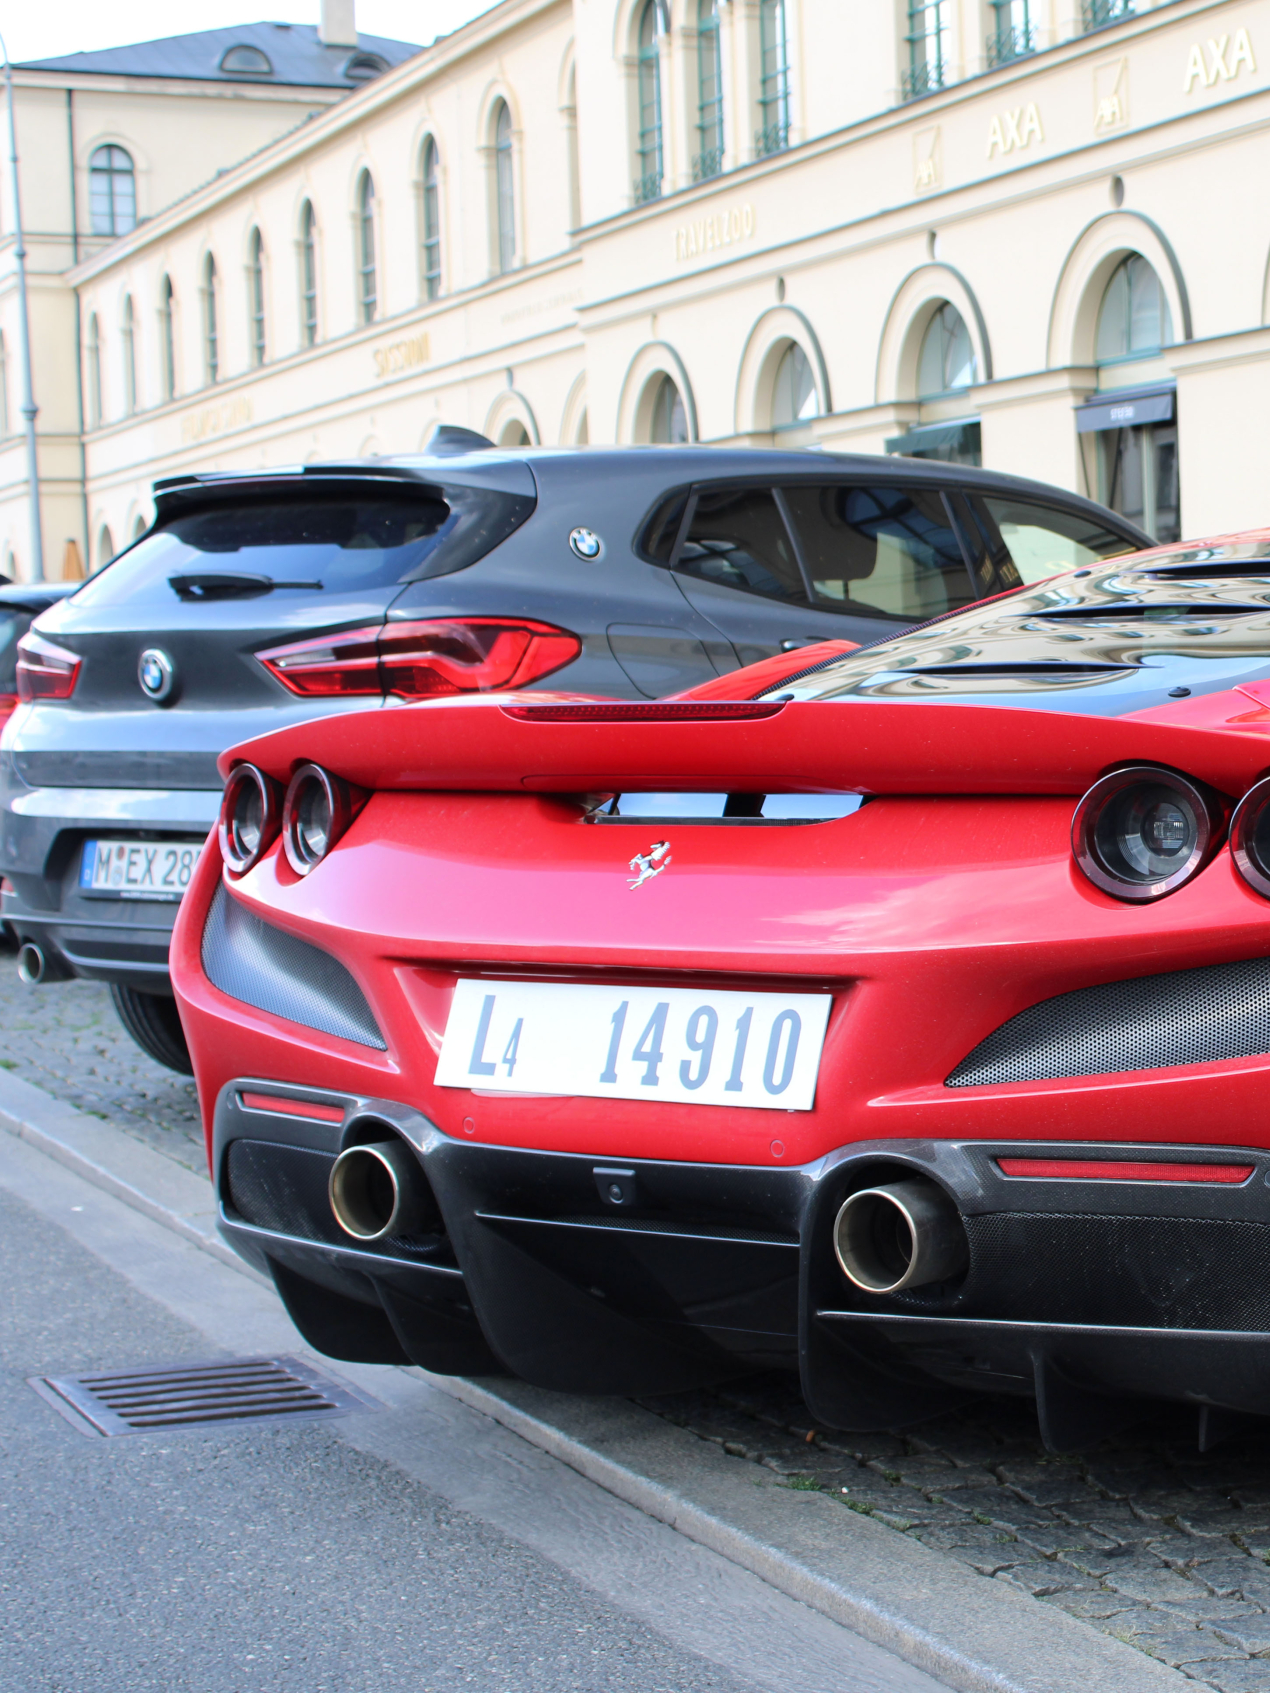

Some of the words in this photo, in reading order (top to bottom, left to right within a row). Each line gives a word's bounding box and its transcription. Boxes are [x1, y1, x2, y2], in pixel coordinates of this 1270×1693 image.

[1183, 27, 1257, 93] AXA
[986, 102, 1045, 159] AXA
[672, 203, 755, 260] TRAVELZOO
[95, 847, 112, 883] M
[126, 849, 157, 885] EX
[161, 851, 201, 886] 28
[599, 1000, 802, 1096] 14910
